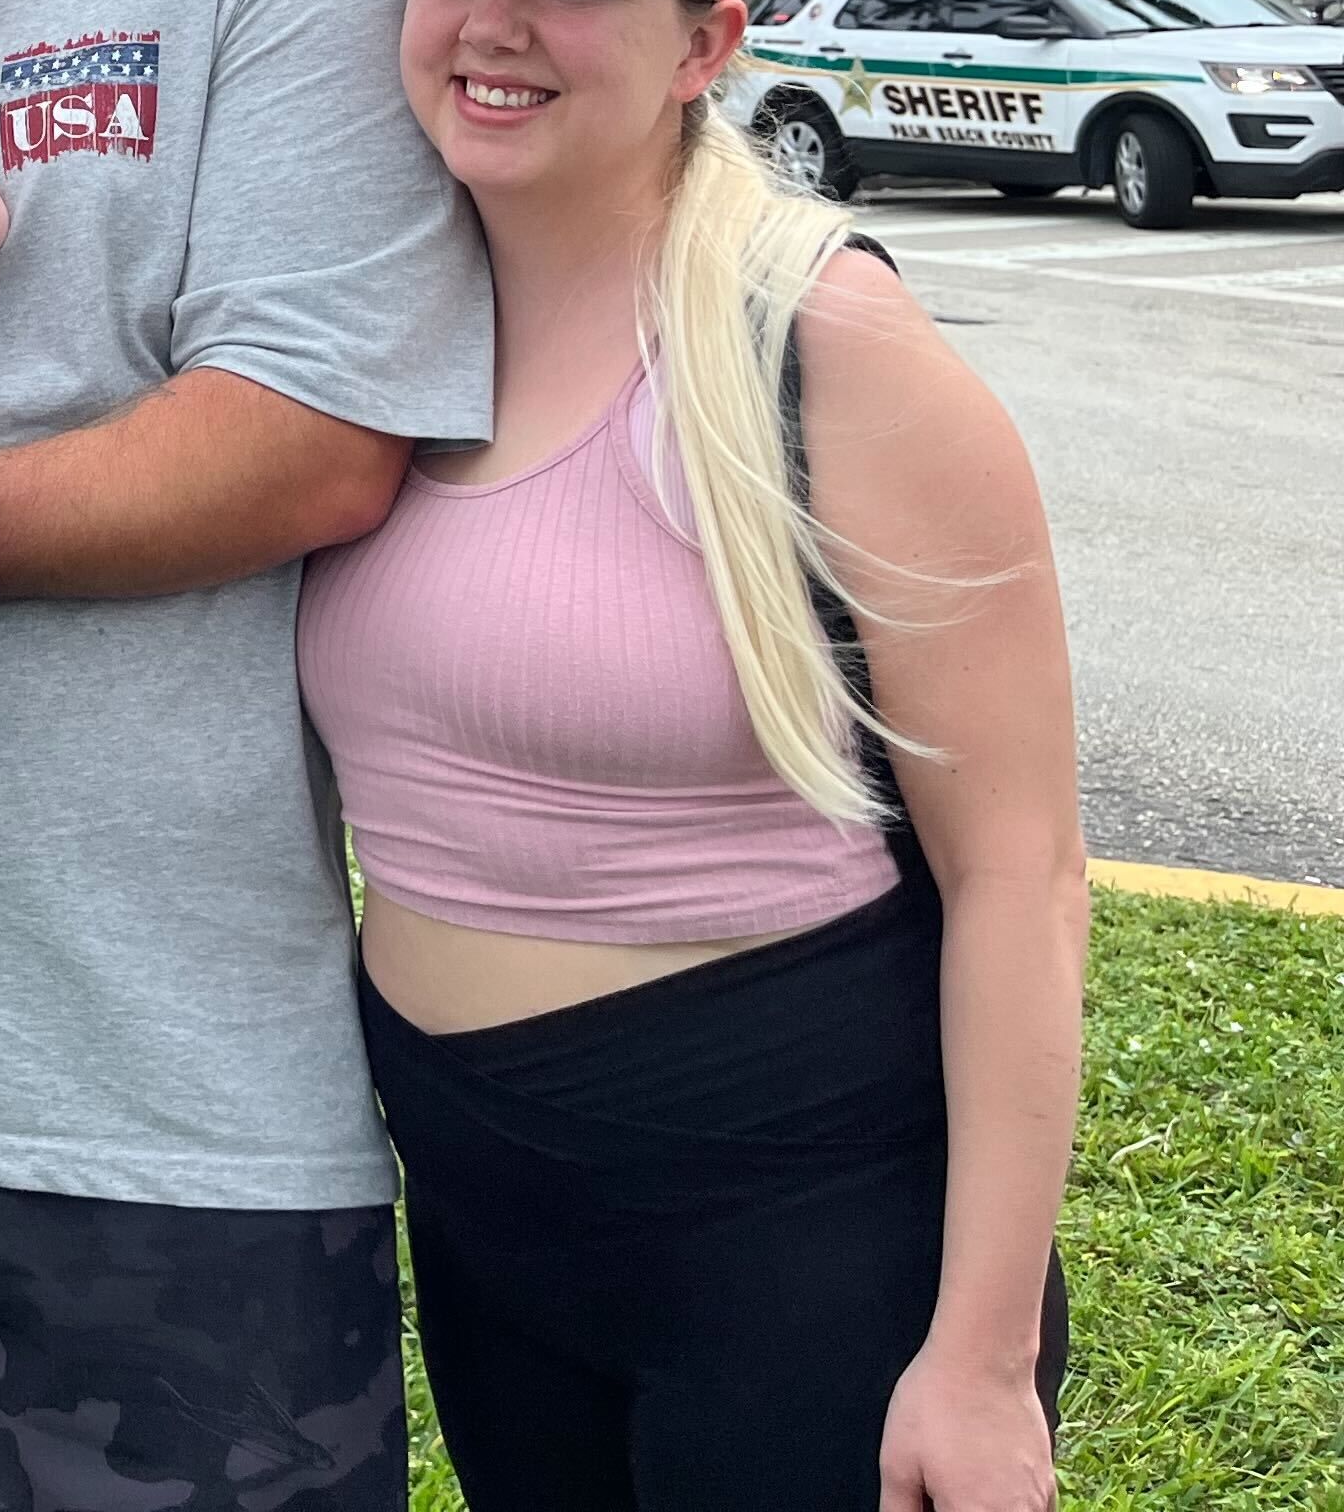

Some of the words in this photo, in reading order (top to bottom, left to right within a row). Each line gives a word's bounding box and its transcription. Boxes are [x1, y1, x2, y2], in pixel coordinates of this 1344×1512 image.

[7, 92, 150, 152] USA
[882, 84, 1043, 125] SHERIFF
[890, 123, 931, 140] PALM
[936, 125, 987, 145] BEACH
[991, 129, 1057, 152] COUNTY
